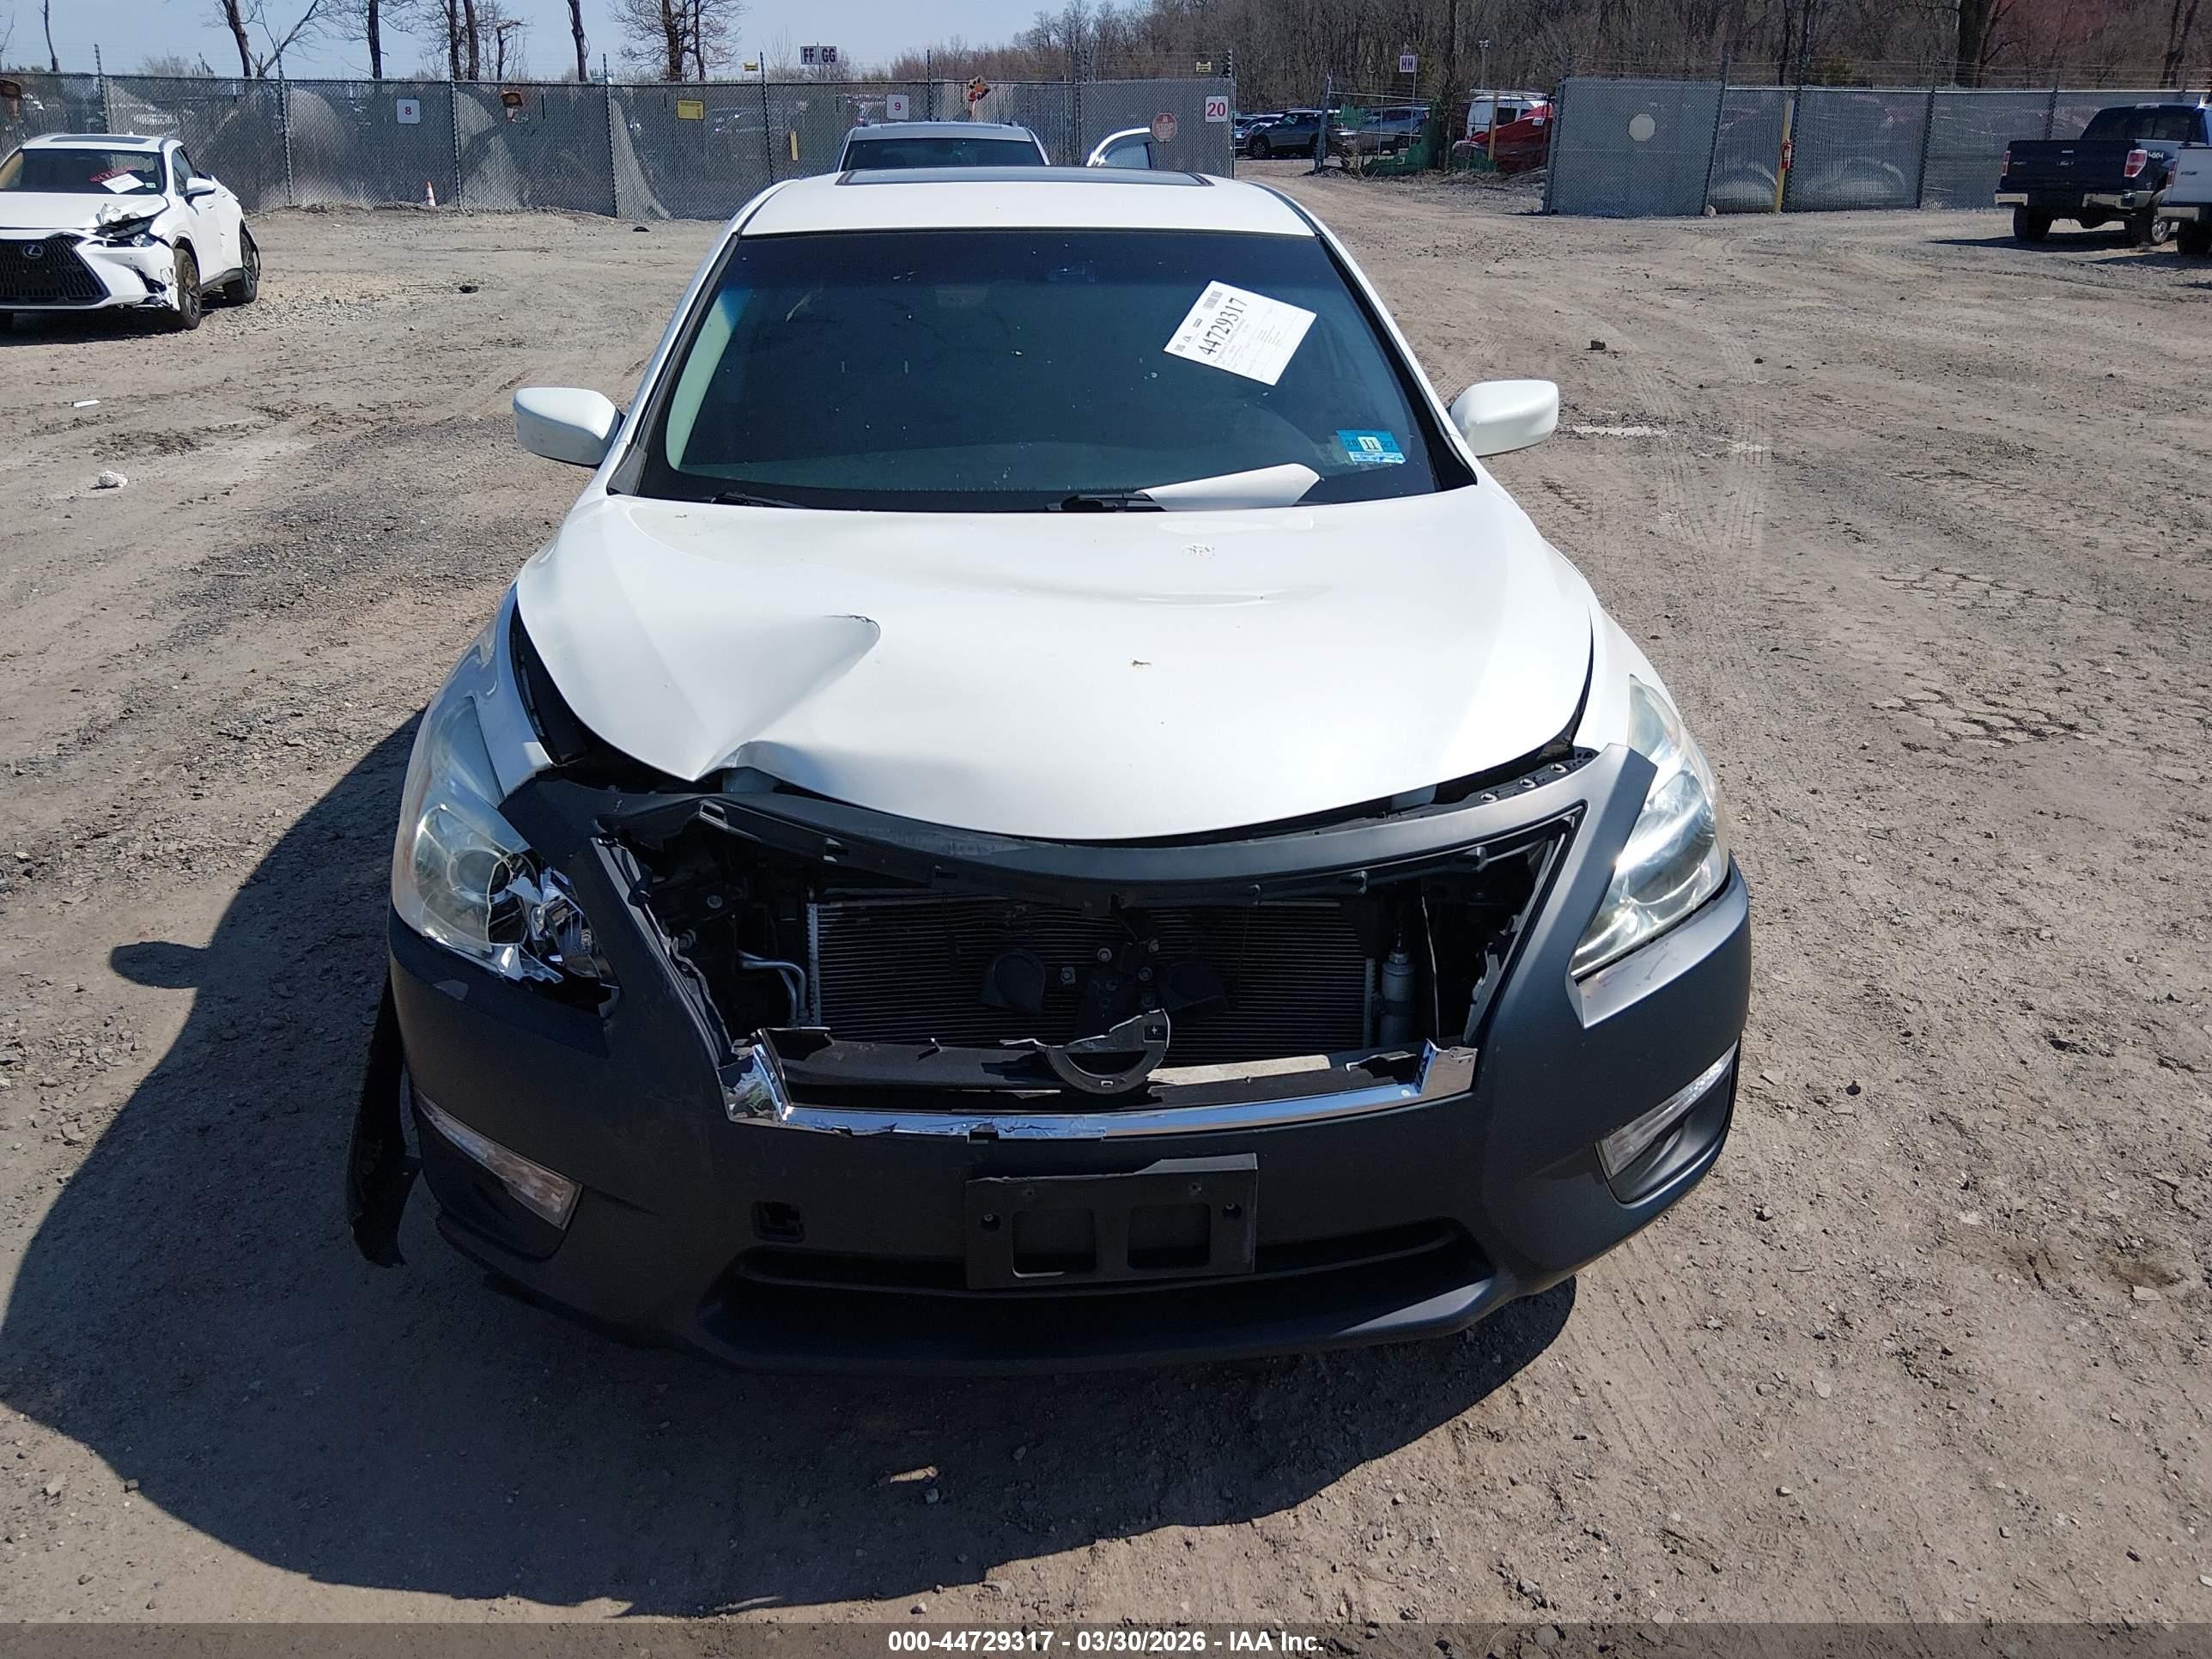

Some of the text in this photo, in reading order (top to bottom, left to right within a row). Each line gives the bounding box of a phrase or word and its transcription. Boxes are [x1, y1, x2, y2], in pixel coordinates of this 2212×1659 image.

[803, 47, 814, 63] FF
[822, 47, 836, 63] GG
[404, 106, 412, 116] 8
[894, 101, 902, 111] 9
[1206, 101, 1226, 117] 20
[1156, 123, 1174, 131] STOP
[1196, 296, 1248, 356] 44729317
[1362, 438, 1379, 450] 11
